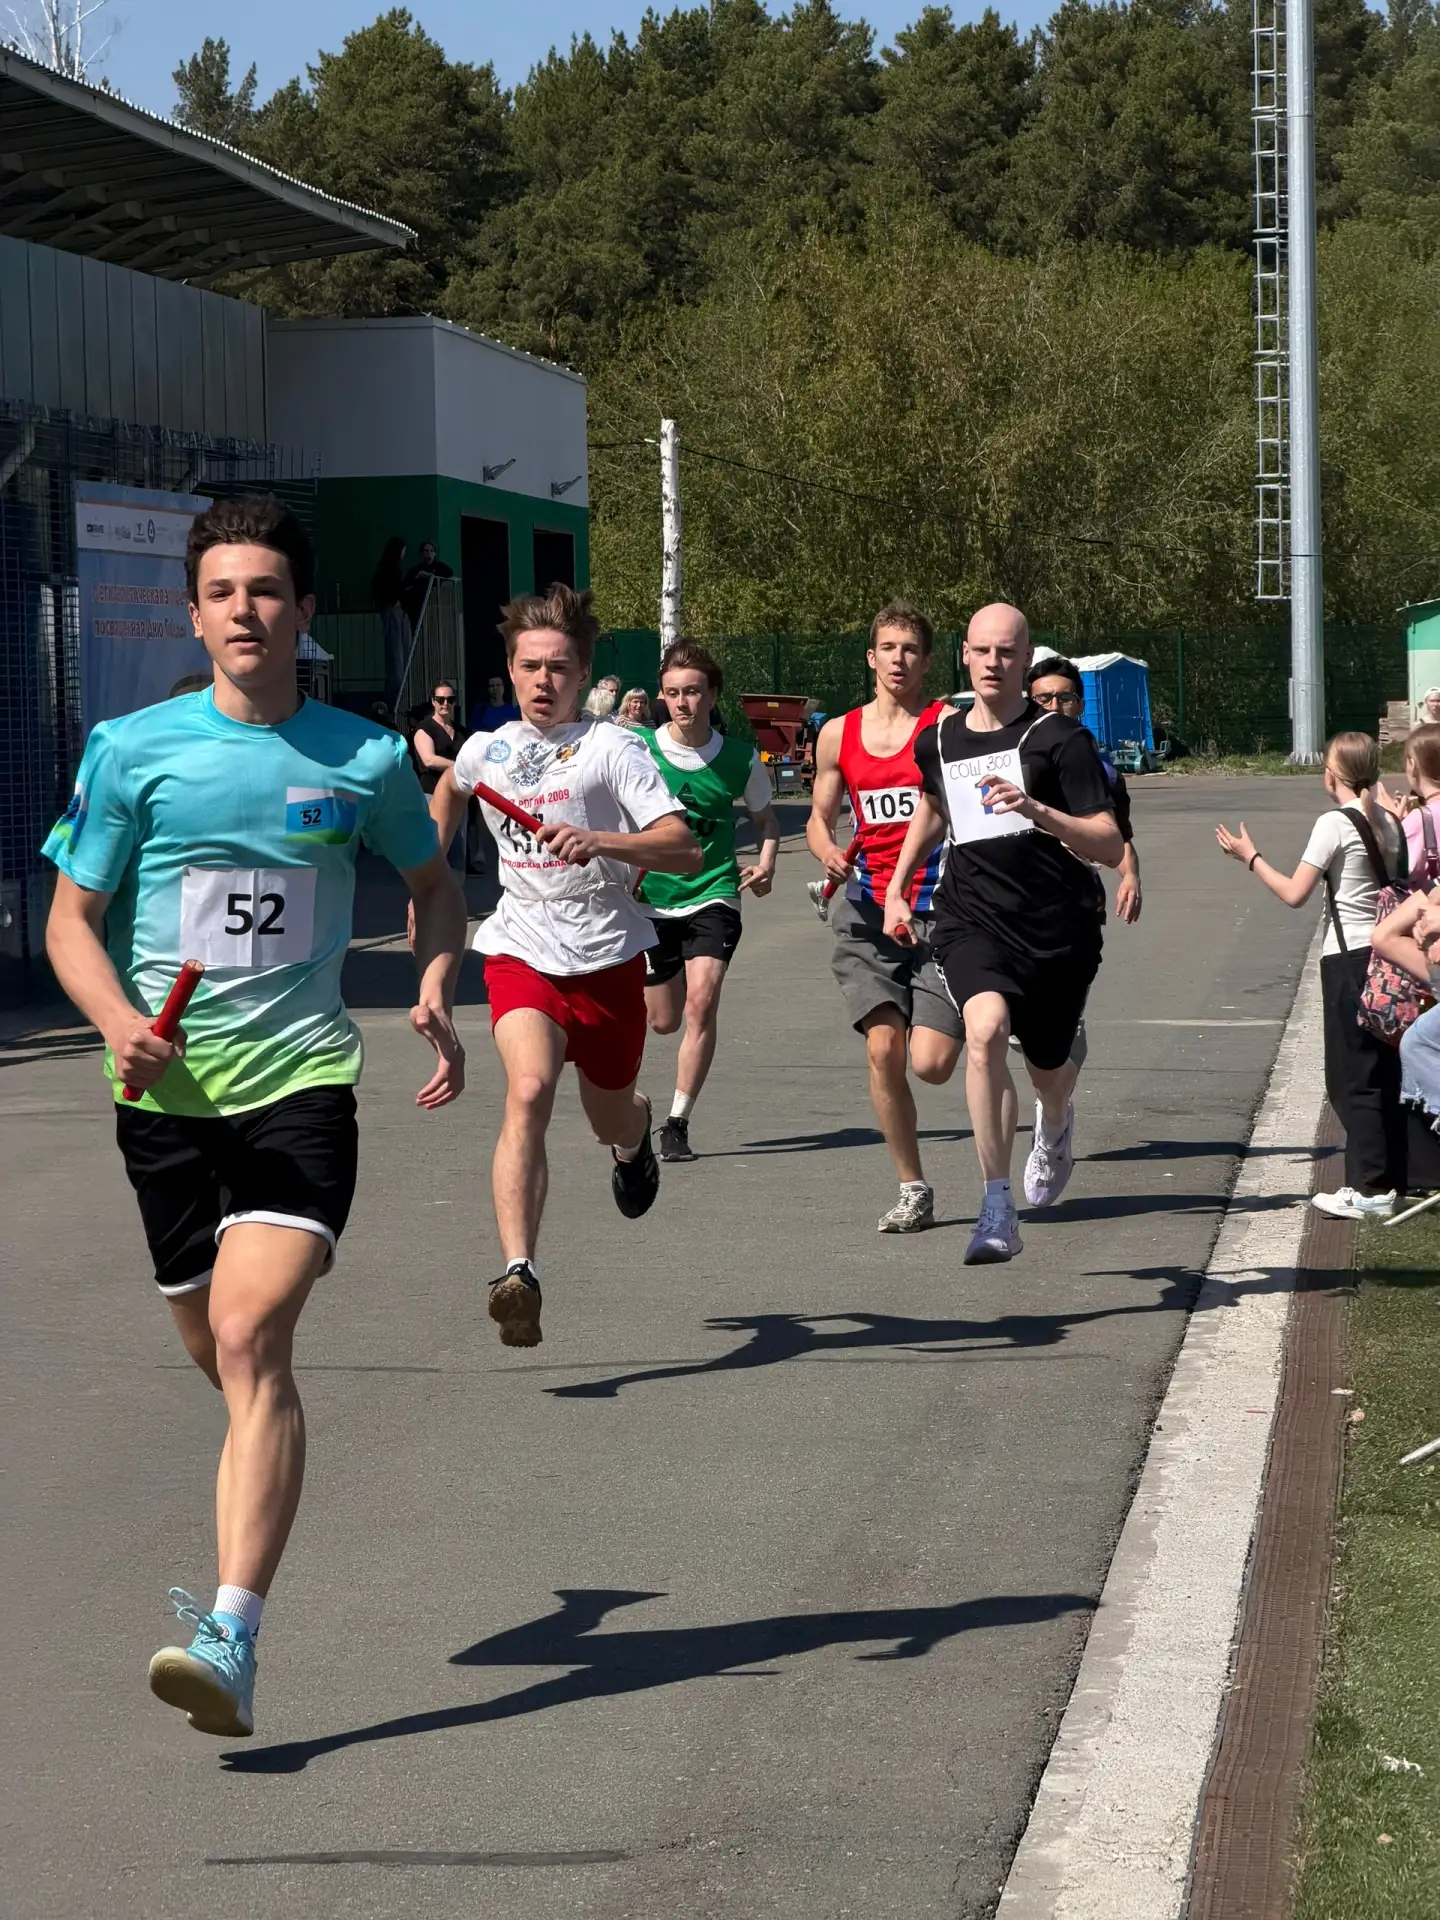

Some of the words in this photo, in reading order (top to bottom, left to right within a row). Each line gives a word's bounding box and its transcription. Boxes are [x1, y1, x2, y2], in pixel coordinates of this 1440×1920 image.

[949, 759, 981, 780] СОШ
[986, 753, 1012, 771] 300
[547, 788, 570, 804] 2009
[865, 791, 915, 820] 105
[300, 807, 322, 827] 52
[224, 892, 286, 936] 52
